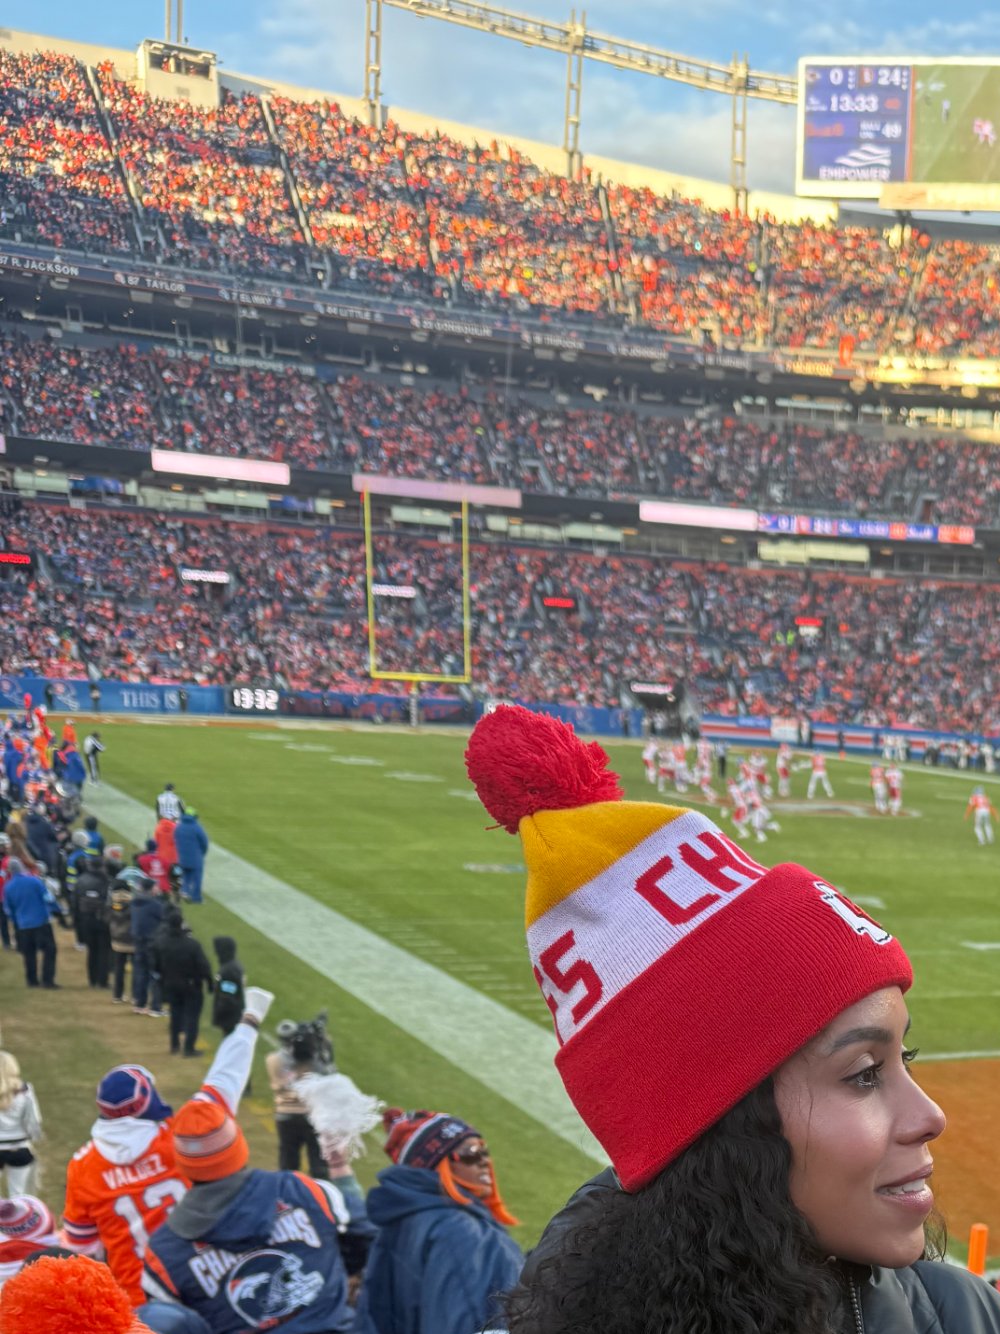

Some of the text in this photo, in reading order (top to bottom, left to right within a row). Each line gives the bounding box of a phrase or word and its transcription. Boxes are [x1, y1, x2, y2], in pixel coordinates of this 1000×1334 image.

[829, 67, 844, 86] 0
[878, 67, 901, 86] 24
[24, 259, 79, 276] JACKSON
[145, 278, 186, 293] TAYLOR
[119, 688, 158, 709] THIS
[633, 830, 771, 927] CH
